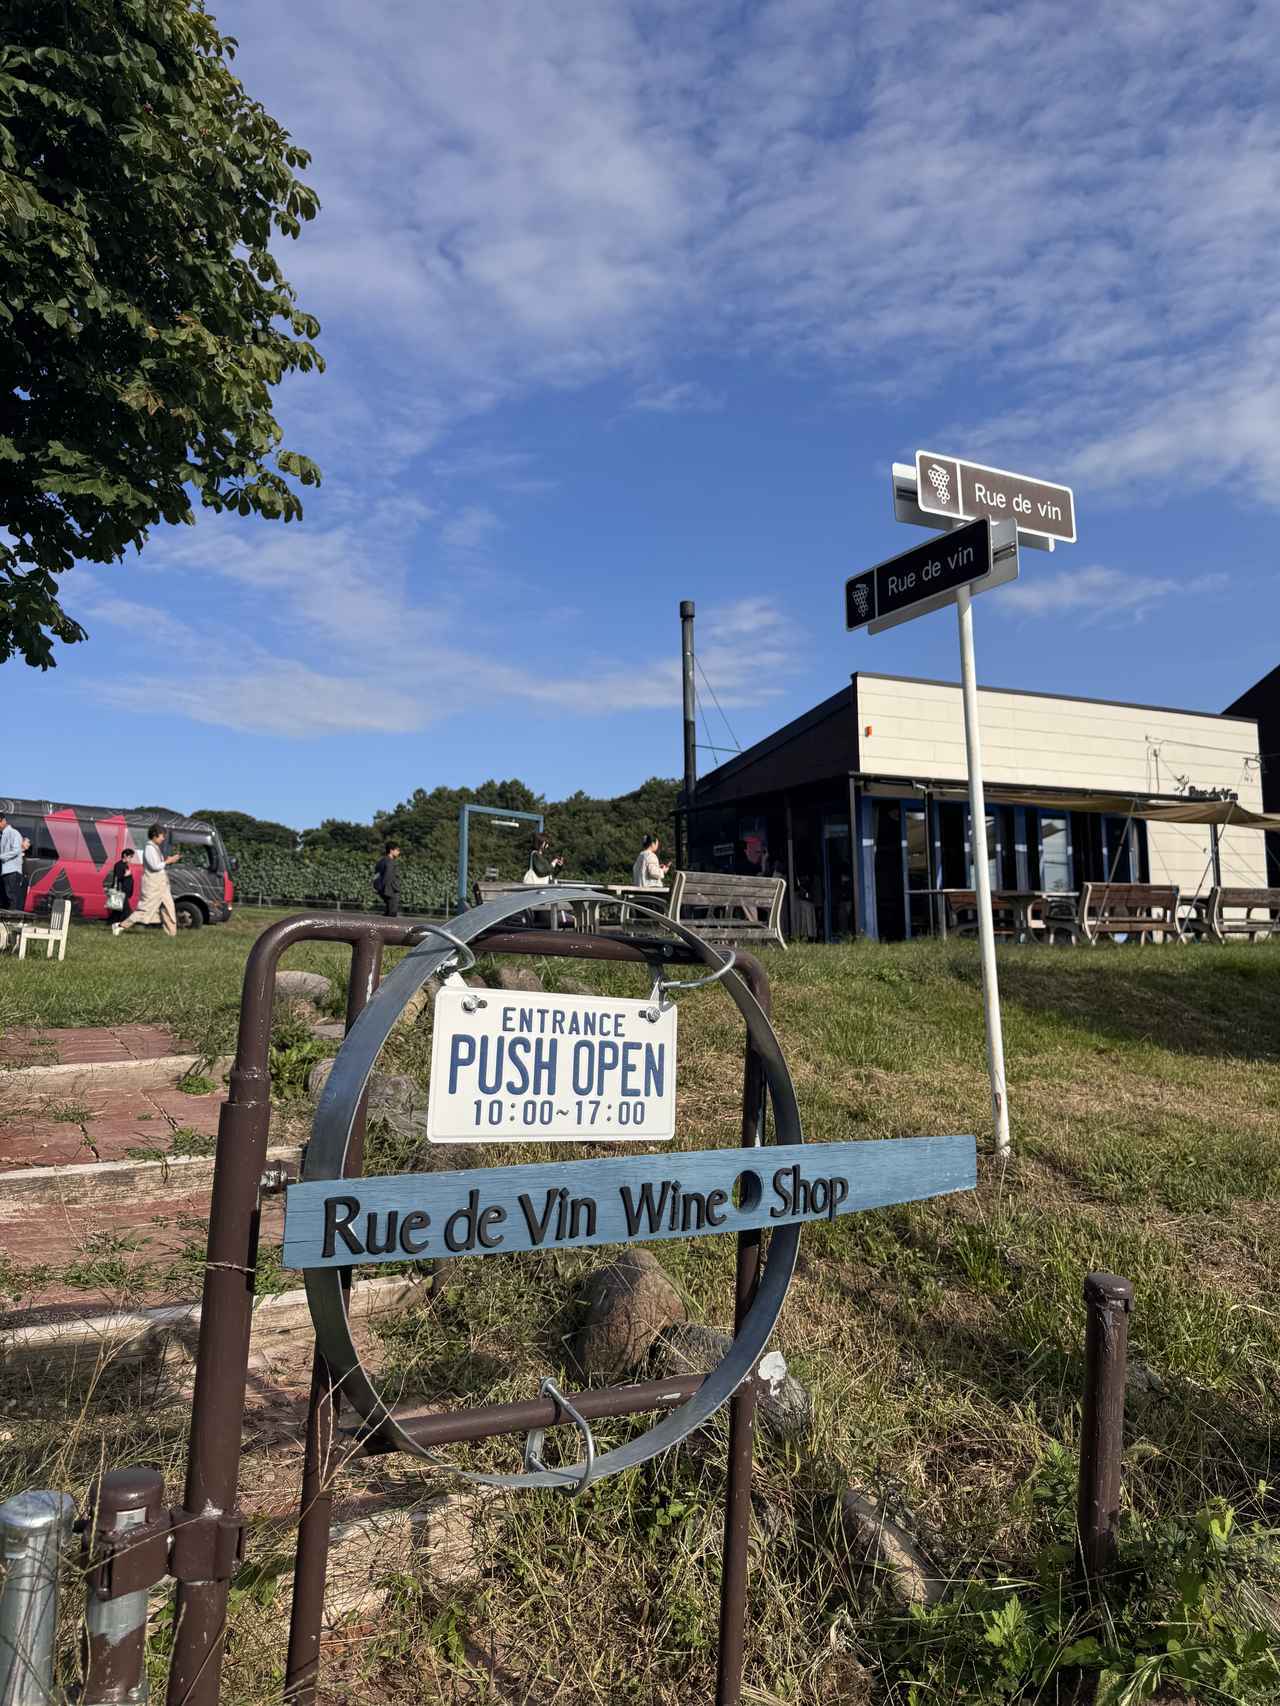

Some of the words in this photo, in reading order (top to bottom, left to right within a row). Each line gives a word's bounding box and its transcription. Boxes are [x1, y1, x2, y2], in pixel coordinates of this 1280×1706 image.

[974, 482, 1007, 509] Rue
[1012, 492, 1032, 514] de
[1038, 500, 1062, 521] vin
[887, 573, 916, 596] Rue
[922, 559, 942, 582] de
[948, 546, 975, 570] vin
[502, 1006, 626, 1038] ENTRANCE
[448, 1033, 558, 1096] PUSH
[571, 1039, 665, 1098] OPEN
[321, 1195, 432, 1258] Rue
[444, 1188, 509, 1252] de
[518, 1186, 598, 1246] Vin
[619, 1179, 728, 1237] Wine
[769, 1164, 850, 1224] Shop
